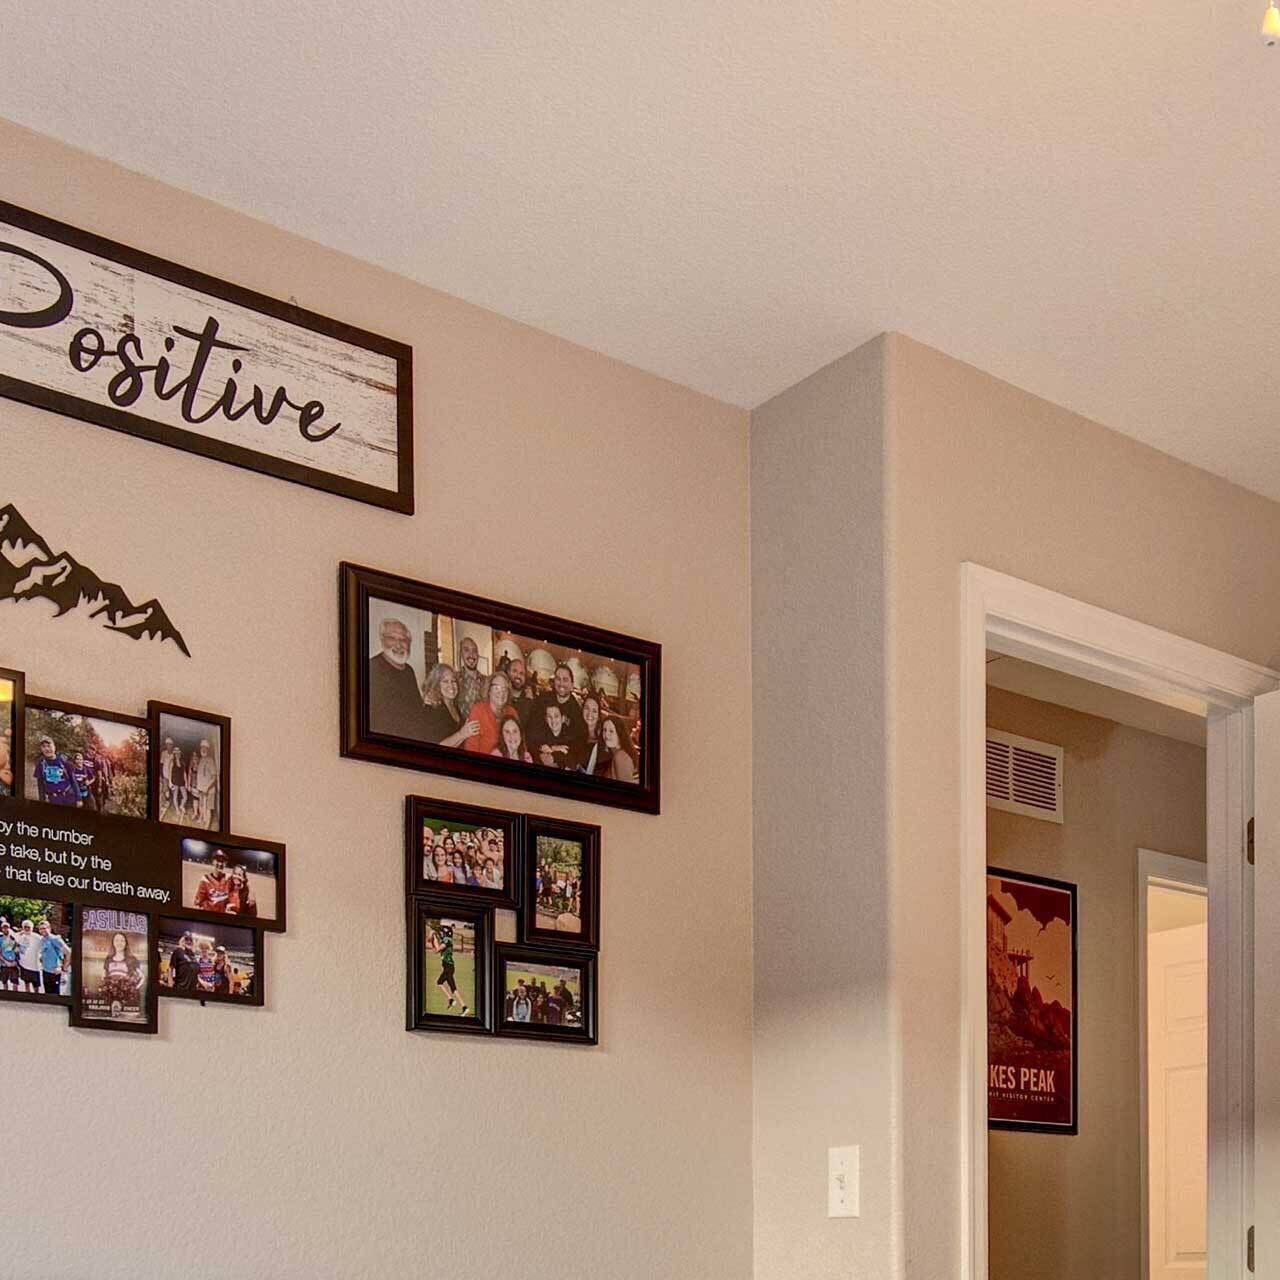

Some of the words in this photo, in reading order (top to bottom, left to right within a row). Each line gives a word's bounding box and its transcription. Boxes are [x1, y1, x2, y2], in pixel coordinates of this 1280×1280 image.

[16, 820, 39, 837] the
[42, 826, 95, 846] number
[10, 843, 42, 862] take,
[44, 848, 68, 864] but
[70, 851, 87, 870] by
[91, 855, 112, 871] the
[5, 865, 32, 882] that
[36, 870, 65, 887] take
[67, 875, 90, 889] our
[92, 876, 134, 896] breath
[136, 885, 171, 903] away.
[1020, 1067, 1055, 1092] PEAK
